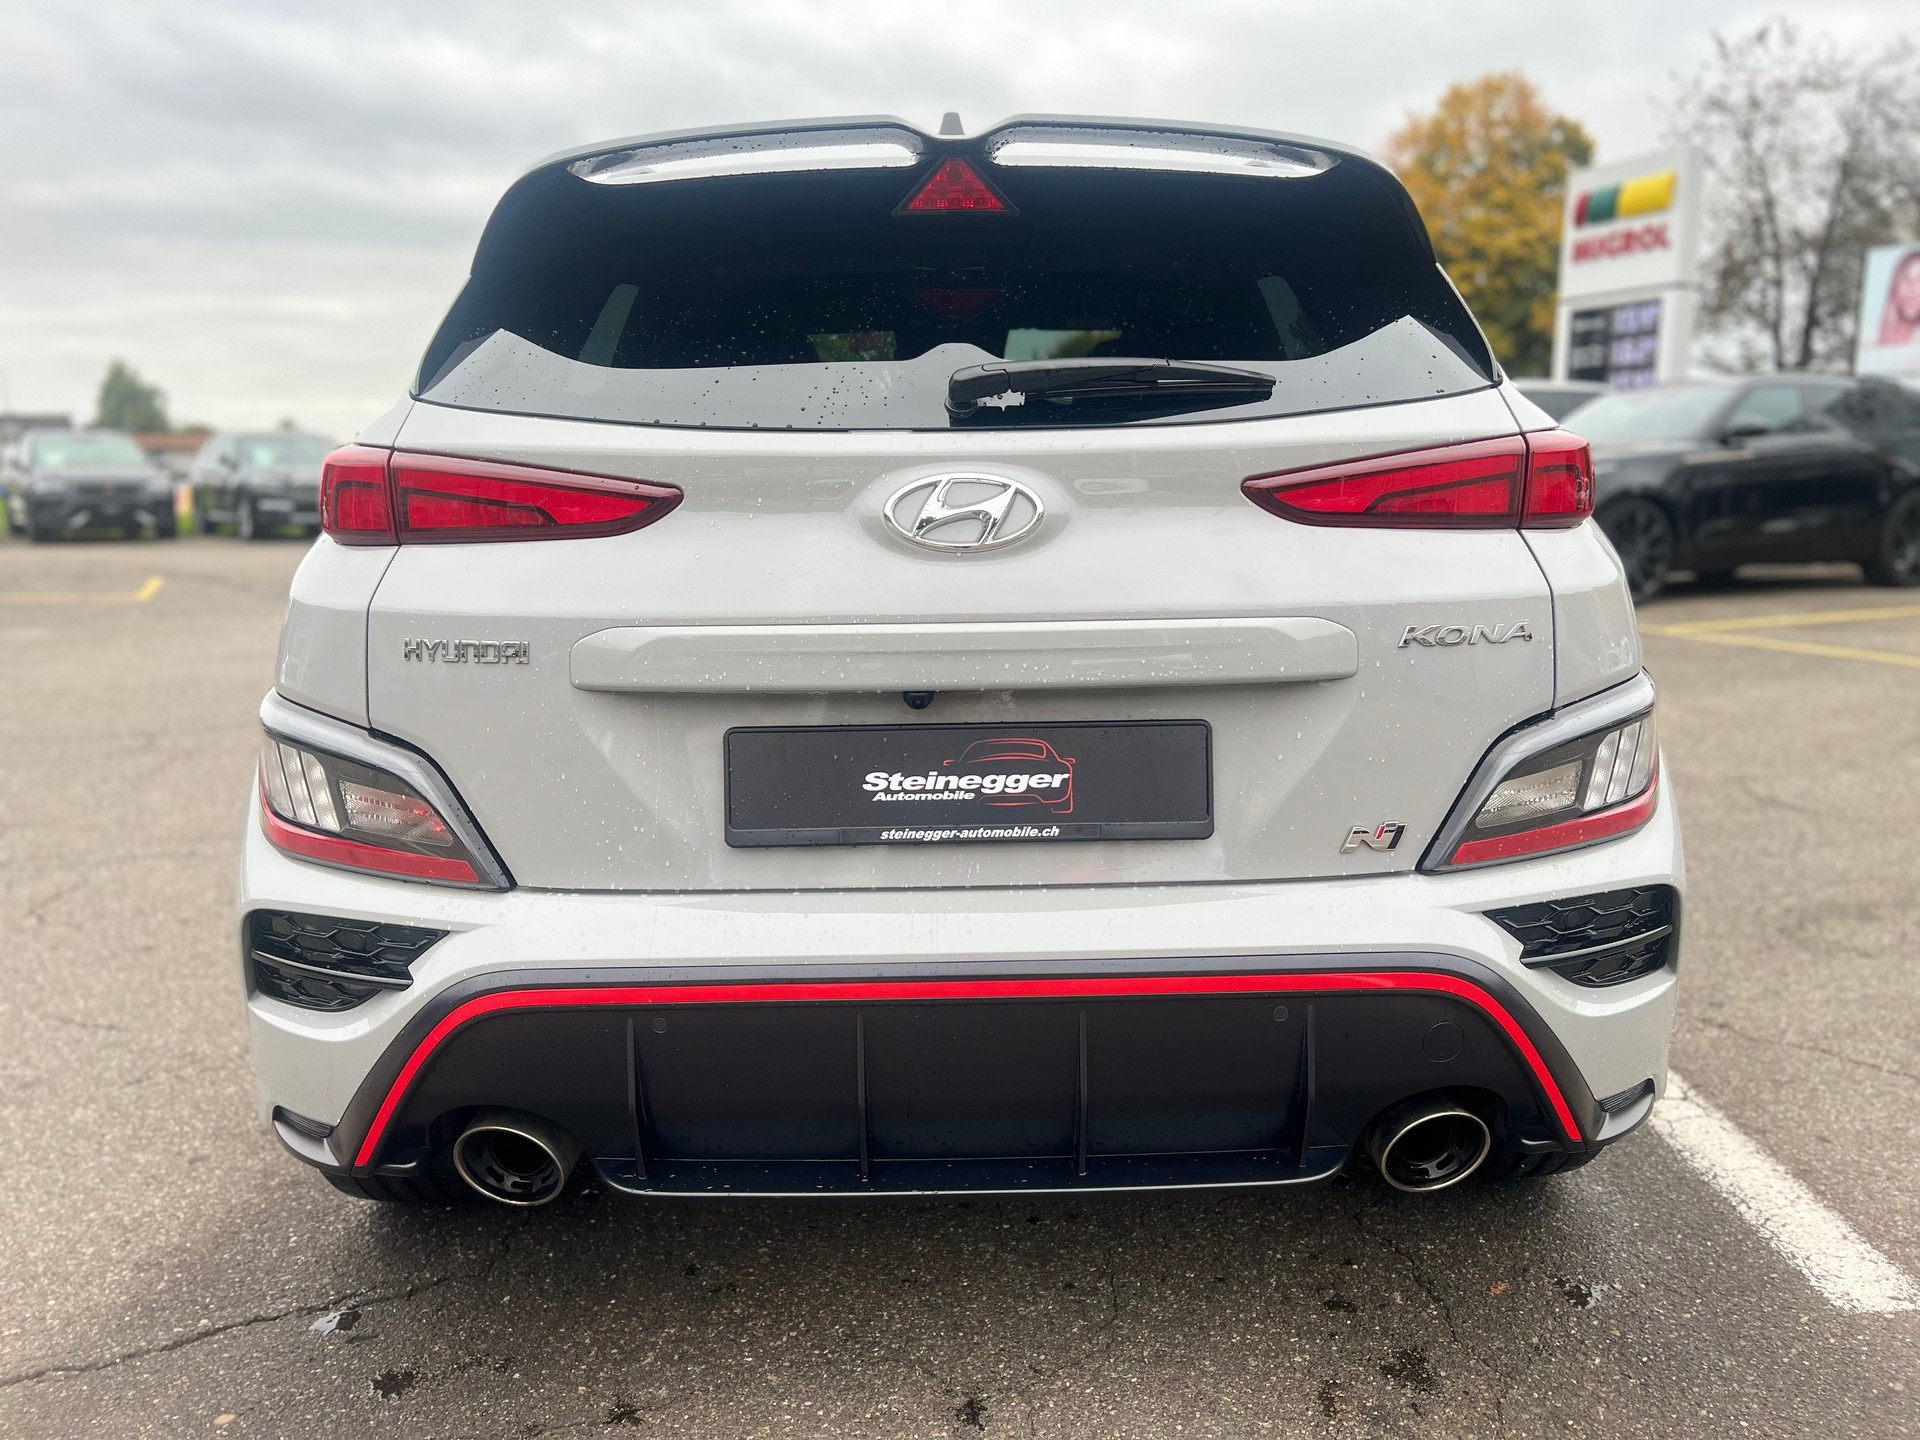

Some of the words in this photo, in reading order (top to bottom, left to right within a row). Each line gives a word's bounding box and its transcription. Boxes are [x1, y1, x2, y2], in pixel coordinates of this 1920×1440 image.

[1398, 621, 1533, 648] KONA
[404, 637, 530, 664] HYUNDAI
[862, 771, 1070, 794] Steinegger
[872, 791, 976, 801] Automobile
[880, 826, 1060, 841] steinegger-automobile.ch
